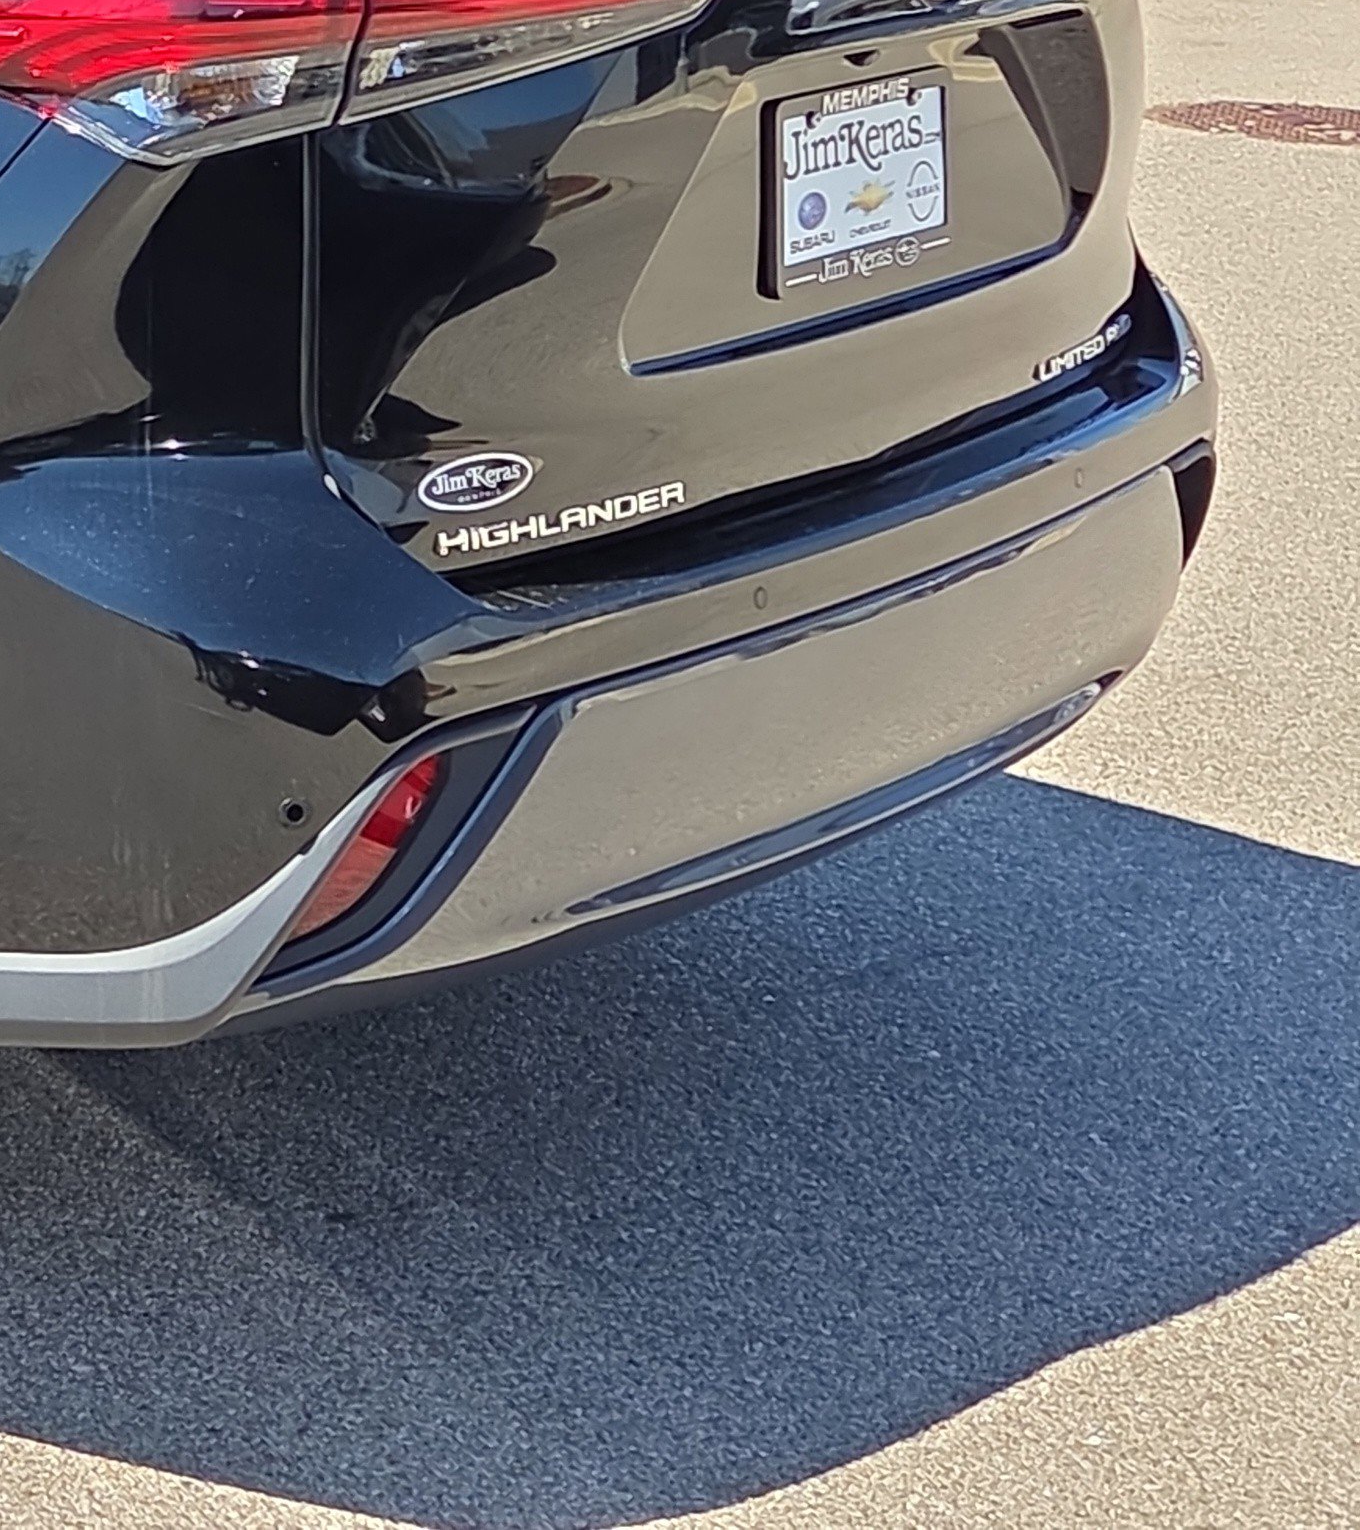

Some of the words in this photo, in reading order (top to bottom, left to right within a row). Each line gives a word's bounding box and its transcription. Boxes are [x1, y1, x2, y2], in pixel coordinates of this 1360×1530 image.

[822, 77, 910, 115] MEMPHIS
[790, 230, 836, 255] SUBARU
[436, 480, 686, 556] HIGHLANDER
